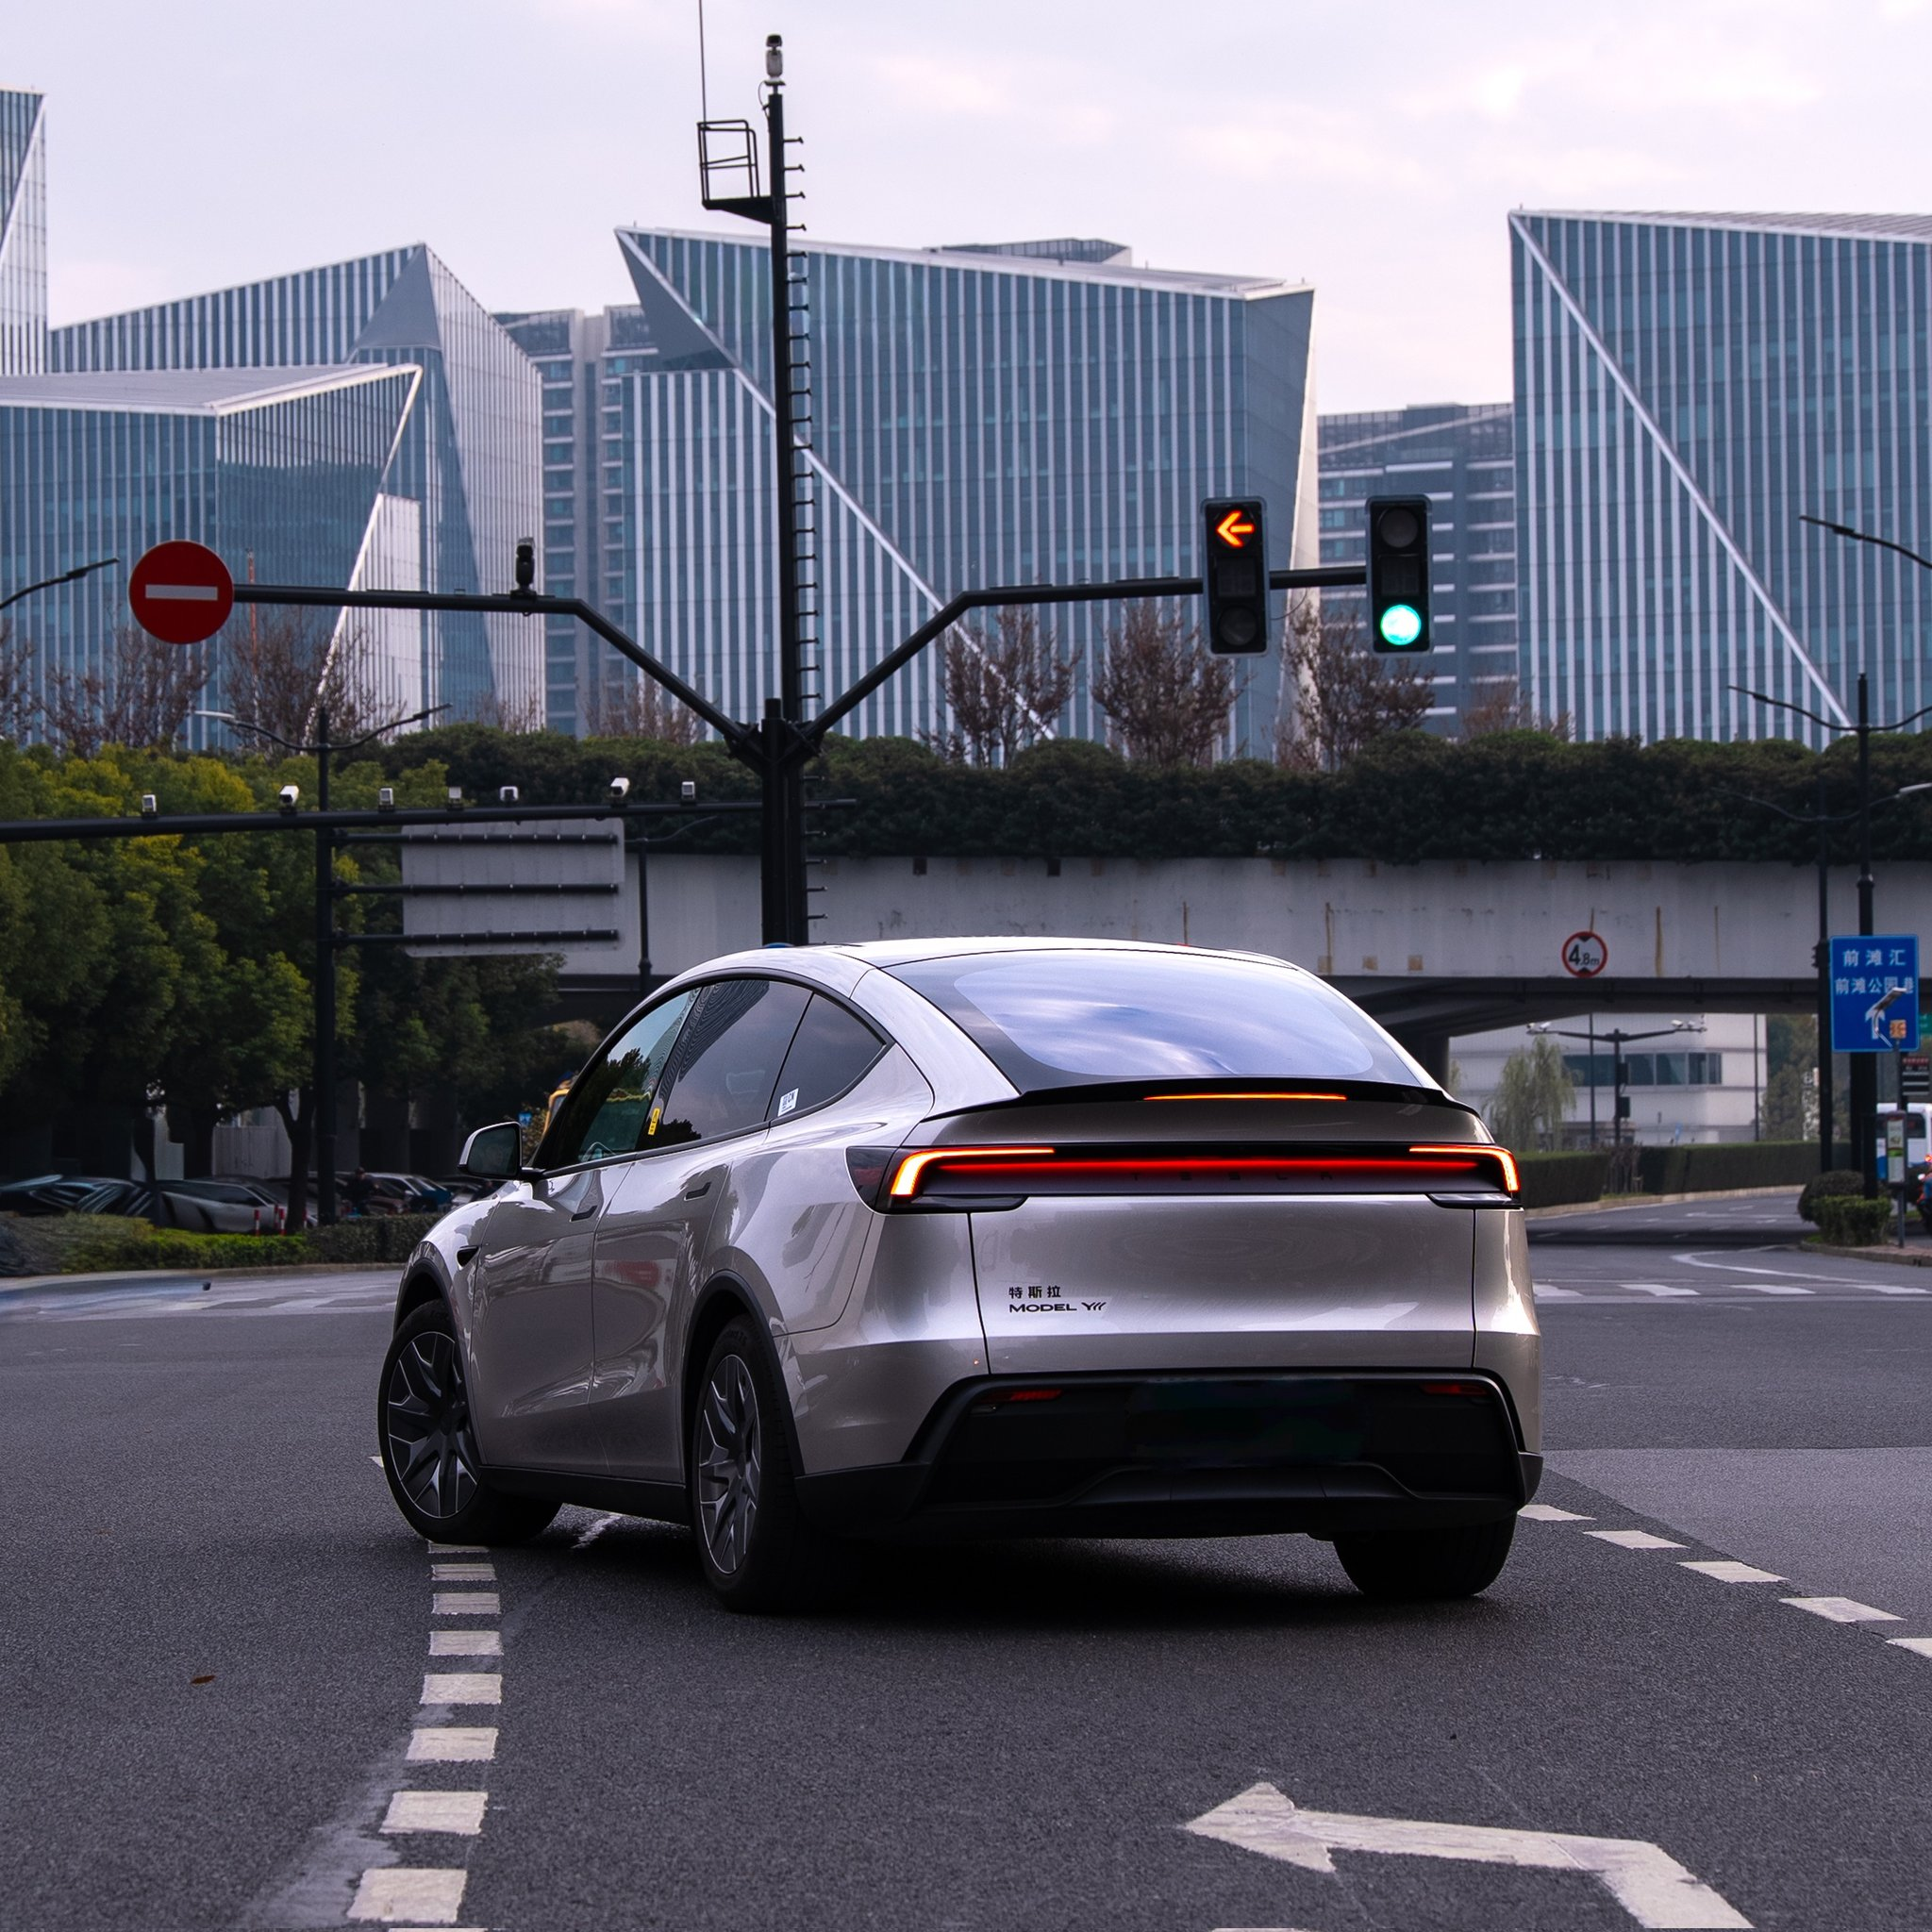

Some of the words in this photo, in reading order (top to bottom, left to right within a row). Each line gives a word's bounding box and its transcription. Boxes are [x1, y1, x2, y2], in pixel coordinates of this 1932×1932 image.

[1842, 948, 1906, 967] 前滩汇
[1008, 1286, 1061, 1299] 特斯拉
[1009, 1304, 1077, 1312] MODEL
